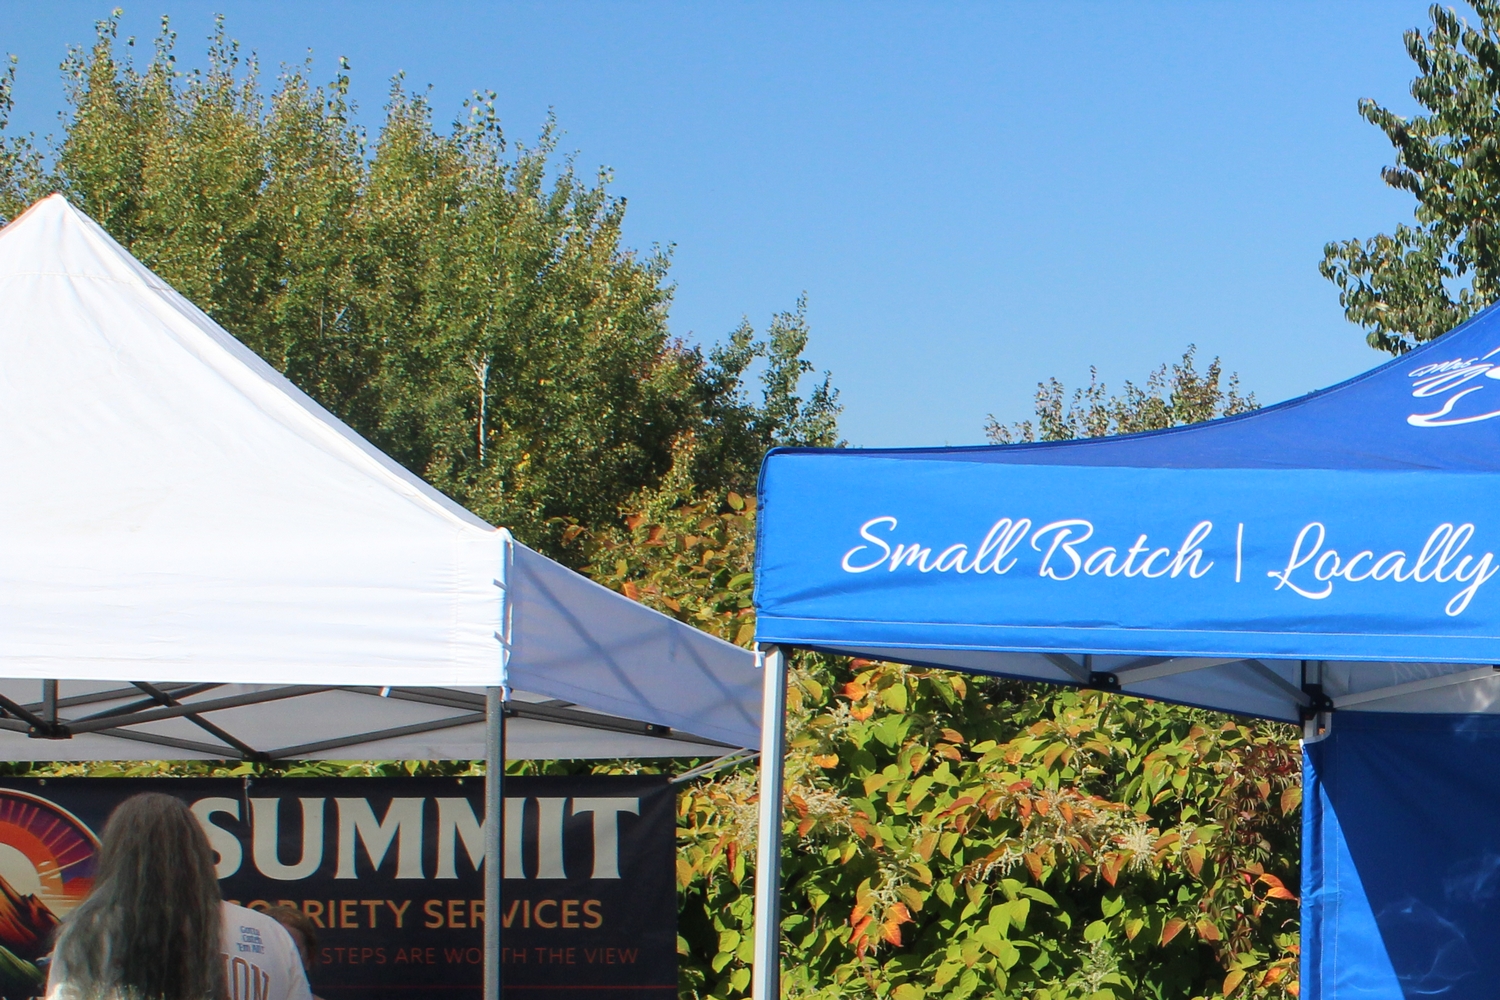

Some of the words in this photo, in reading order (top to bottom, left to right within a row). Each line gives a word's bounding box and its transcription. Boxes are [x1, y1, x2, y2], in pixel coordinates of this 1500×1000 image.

[842, 516, 1032, 574] Small
[1031, 519, 1214, 581] Batch
[1267, 522, 1500, 616] Locally
[190, 797, 639, 880] SUMMIT
[226, 899, 412, 929] RIETY
[321, 947, 387, 965] STEPS
[394, 947, 436, 965] ARE
[443, 947, 527, 965] WOTH
[530, 947, 576, 965] THE
[584, 947, 639, 965] VIEW
